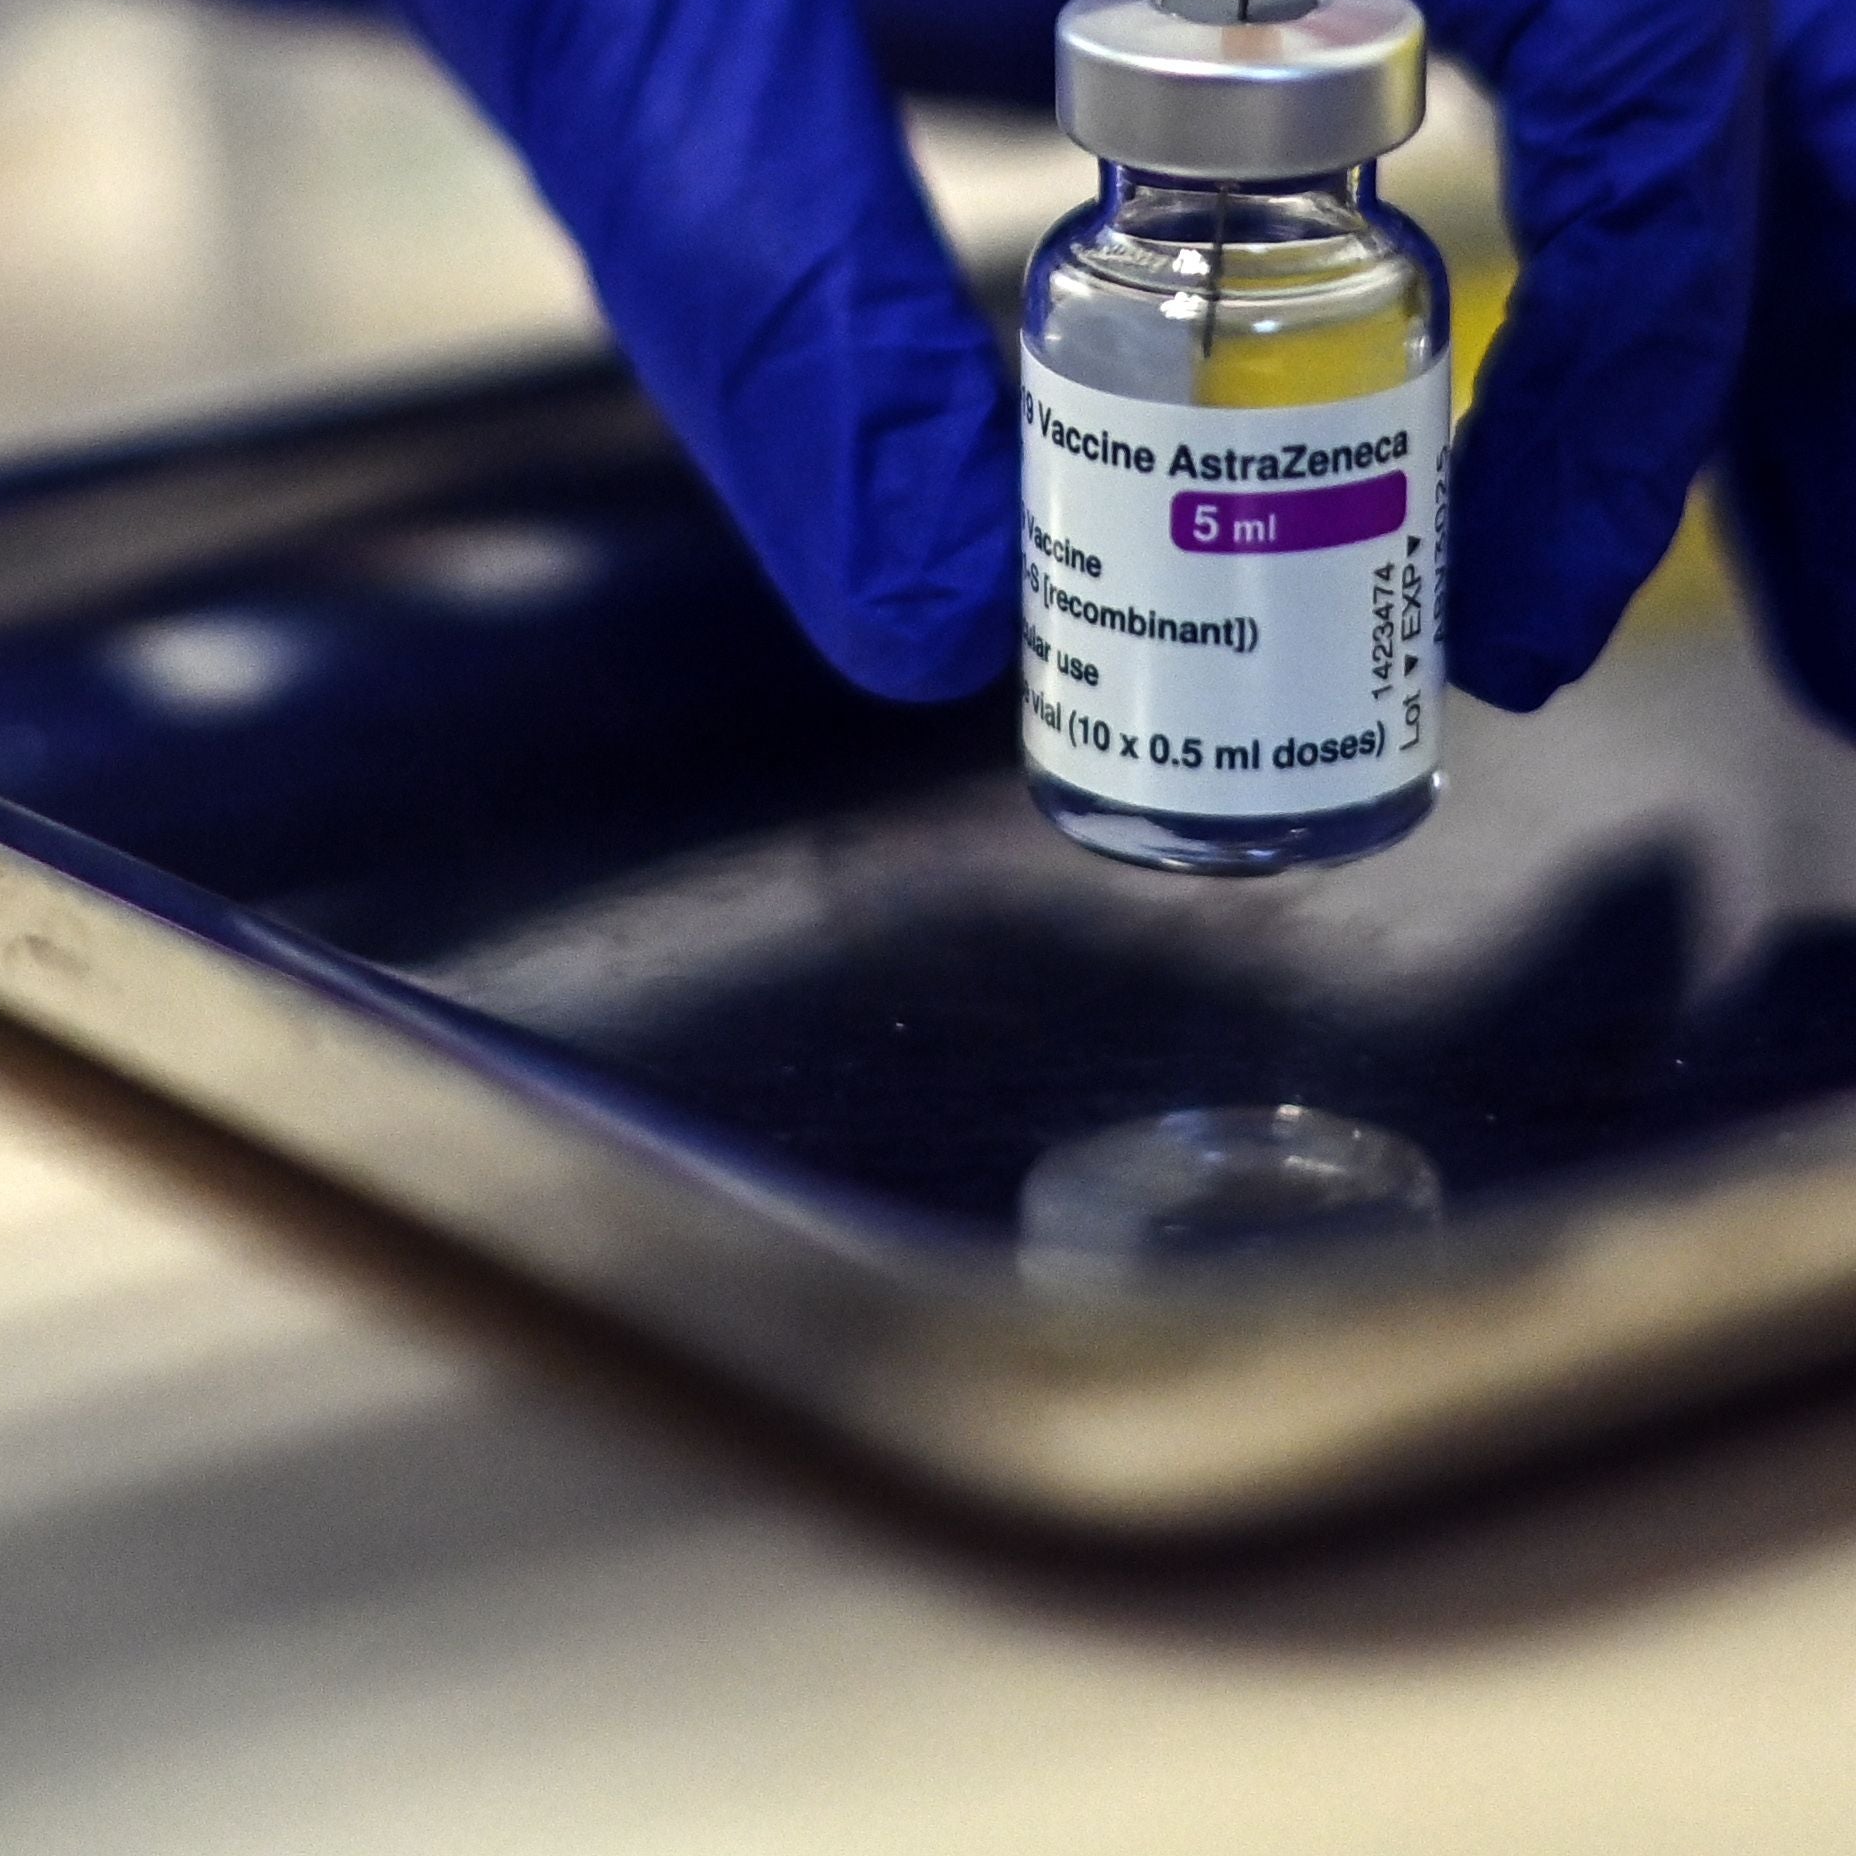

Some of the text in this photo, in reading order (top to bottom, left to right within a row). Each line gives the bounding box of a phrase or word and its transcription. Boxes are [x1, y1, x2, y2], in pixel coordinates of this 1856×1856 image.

[1038, 399, 1155, 473] Vaccine
[1168, 427, 1408, 481] AstraZeneca
[1026, 506, 1102, 578] Vaccine
[1193, 505, 1277, 543] 5 ml
[1043, 574, 1259, 652] [recombinant])
[1371, 561, 1394, 701] 1423474
[1057, 649, 1100, 687] use
[1399, 563, 1421, 751] Lot EXP
[1032, 691, 1062, 732] vial
[1069, 709, 1110, 752] (10
[1120, 732, 1139, 760] x
[1149, 730, 1204, 770] 0.5
[1215, 736, 1259, 771] ml
[1273, 721, 1387, 771] doses)
